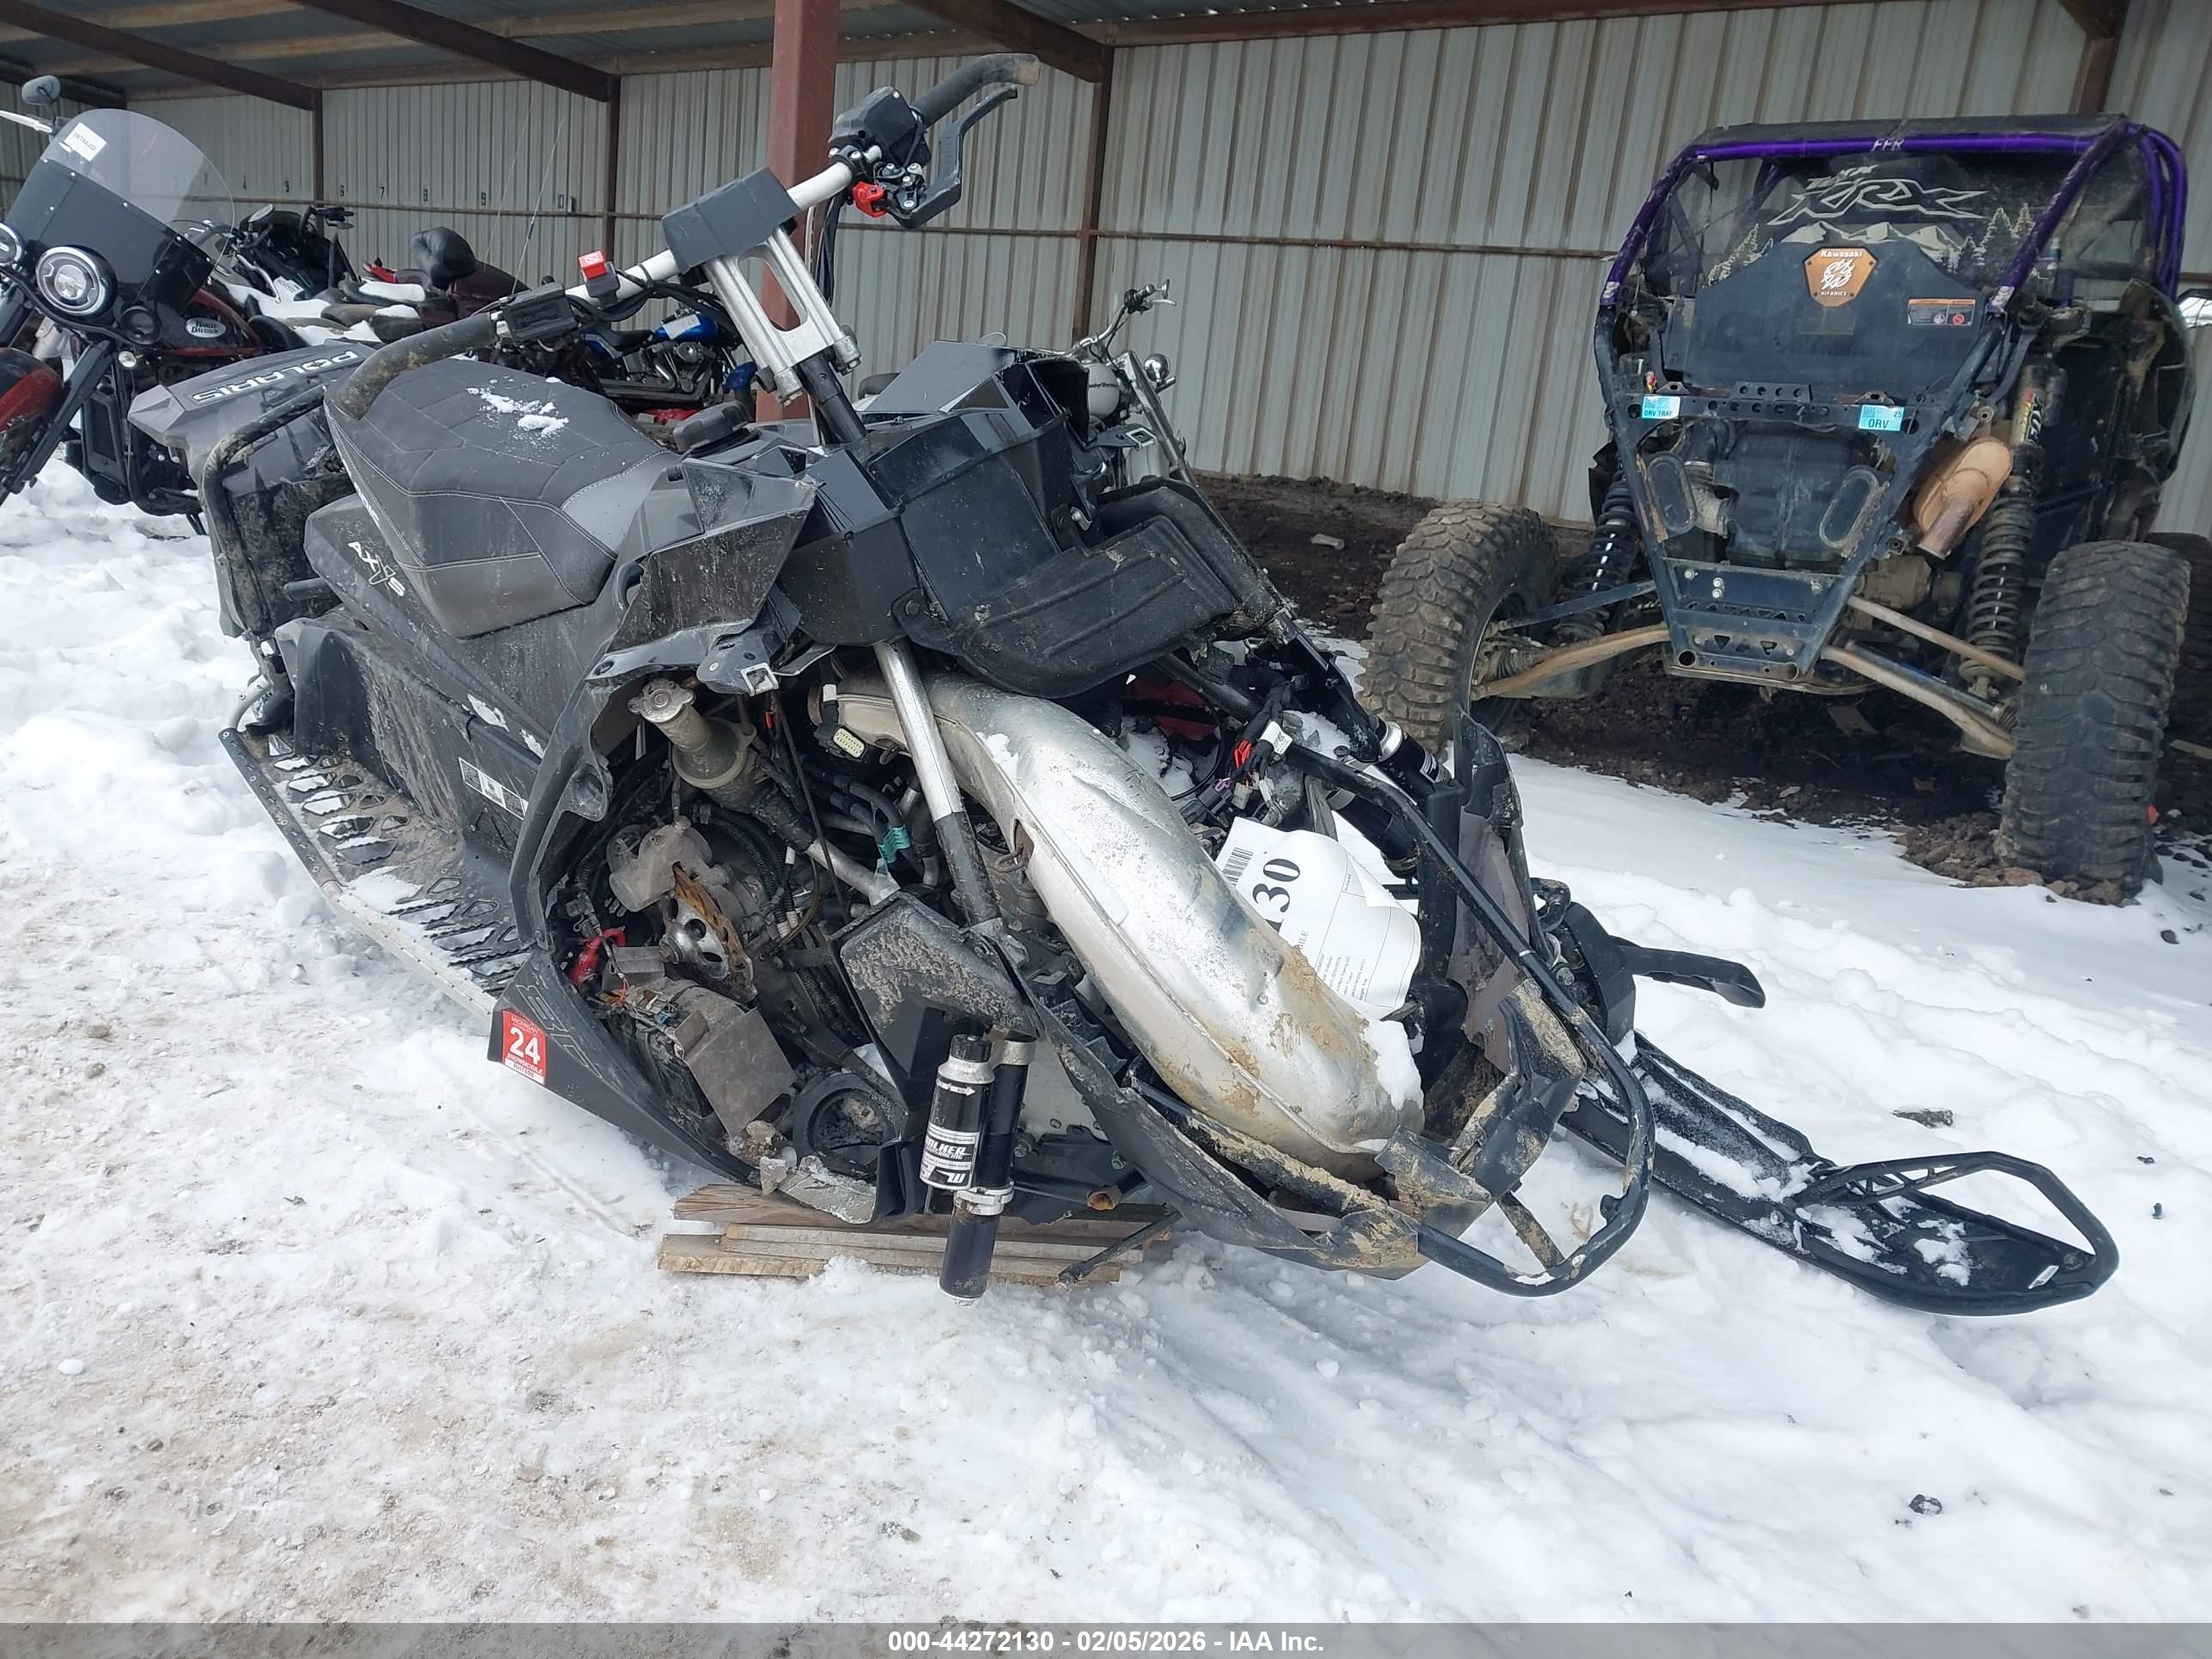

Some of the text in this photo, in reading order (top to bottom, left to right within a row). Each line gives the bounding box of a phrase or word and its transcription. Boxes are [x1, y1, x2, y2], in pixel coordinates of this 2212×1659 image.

[1871, 138, 1905, 152] FFR
[380, 186, 385, 199] 7
[423, 188, 428, 202] 8
[192, 350, 358, 402] POLARIS
[1869, 418, 1889, 428] ORV
[347, 541, 406, 597] AXYS
[511, 1016, 538, 1034] MICHIGAN
[510, 1026, 541, 1066] 24
[507, 1052, 543, 1076] SNOWMOBILE
